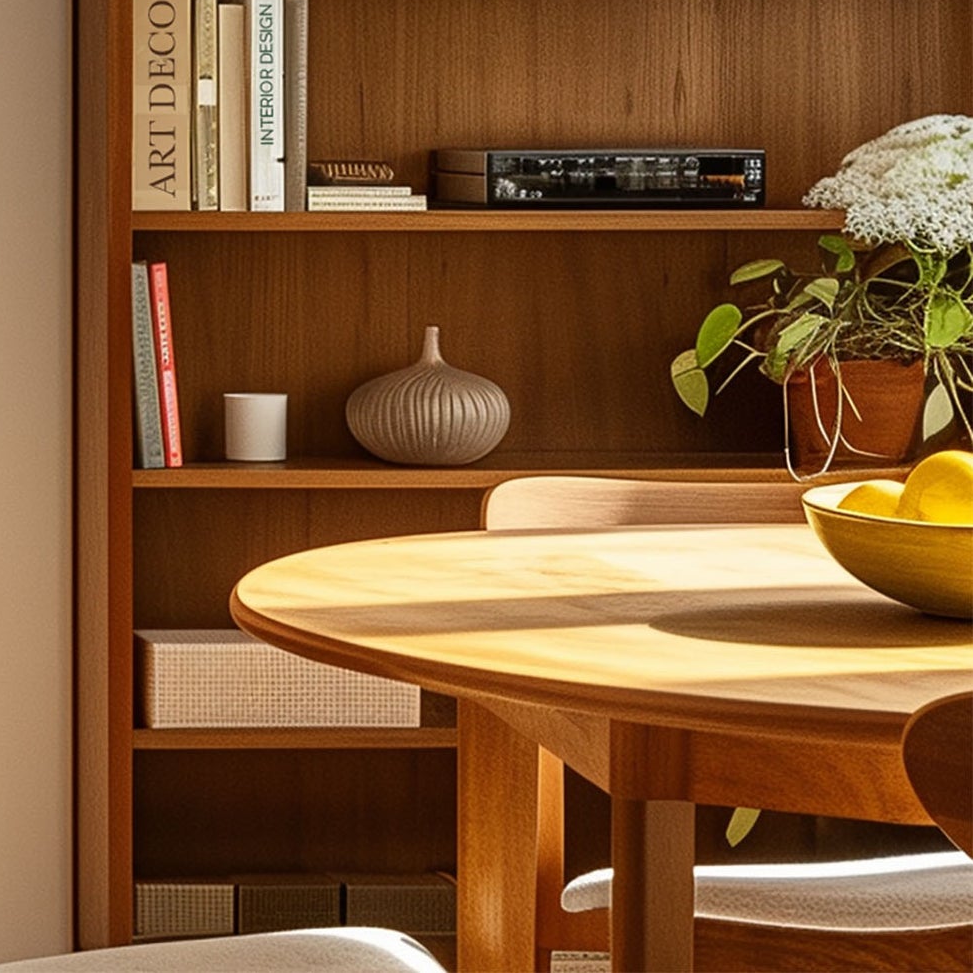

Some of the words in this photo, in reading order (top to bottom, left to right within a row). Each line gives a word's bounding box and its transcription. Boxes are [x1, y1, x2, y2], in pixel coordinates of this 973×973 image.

[147, 0, 176, 111] DECO
[258, 3, 273, 64] DESIGN
[259, 68, 274, 146] INTERIOR
[149, 120, 176, 199] ART
